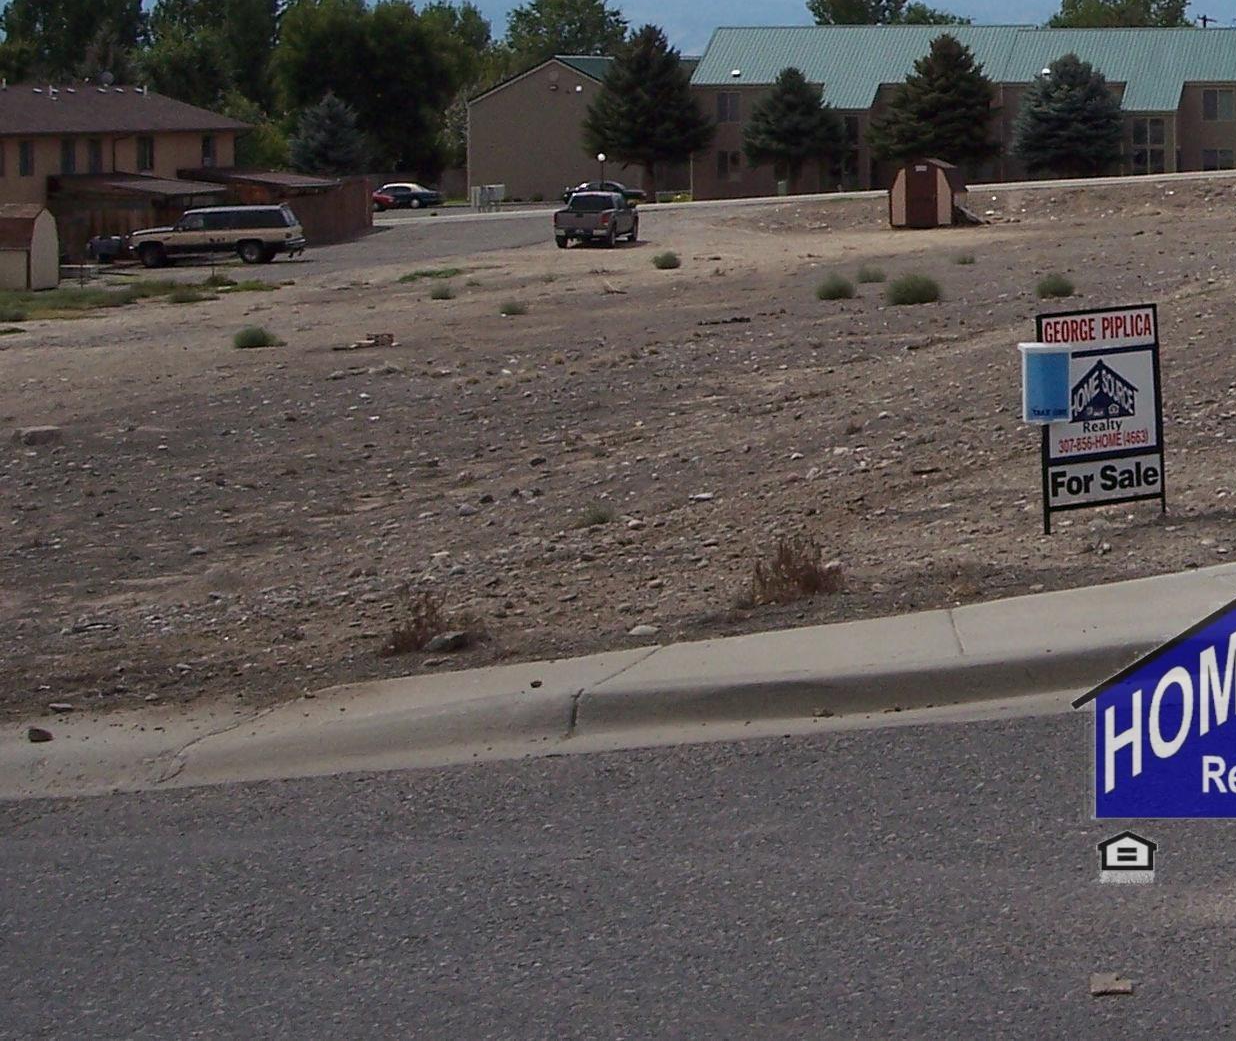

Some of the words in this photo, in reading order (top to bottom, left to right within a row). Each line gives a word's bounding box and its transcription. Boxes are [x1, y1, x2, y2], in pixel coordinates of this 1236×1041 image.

[1044, 318, 1095, 344] GEORGE
[1102, 314, 1152, 339] PIPLICA
[1102, 369, 1134, 415] SOURCE
[1082, 419, 1122, 433] Realty
[1051, 470, 1094, 498] For
[1100, 462, 1159, 491] Sale
